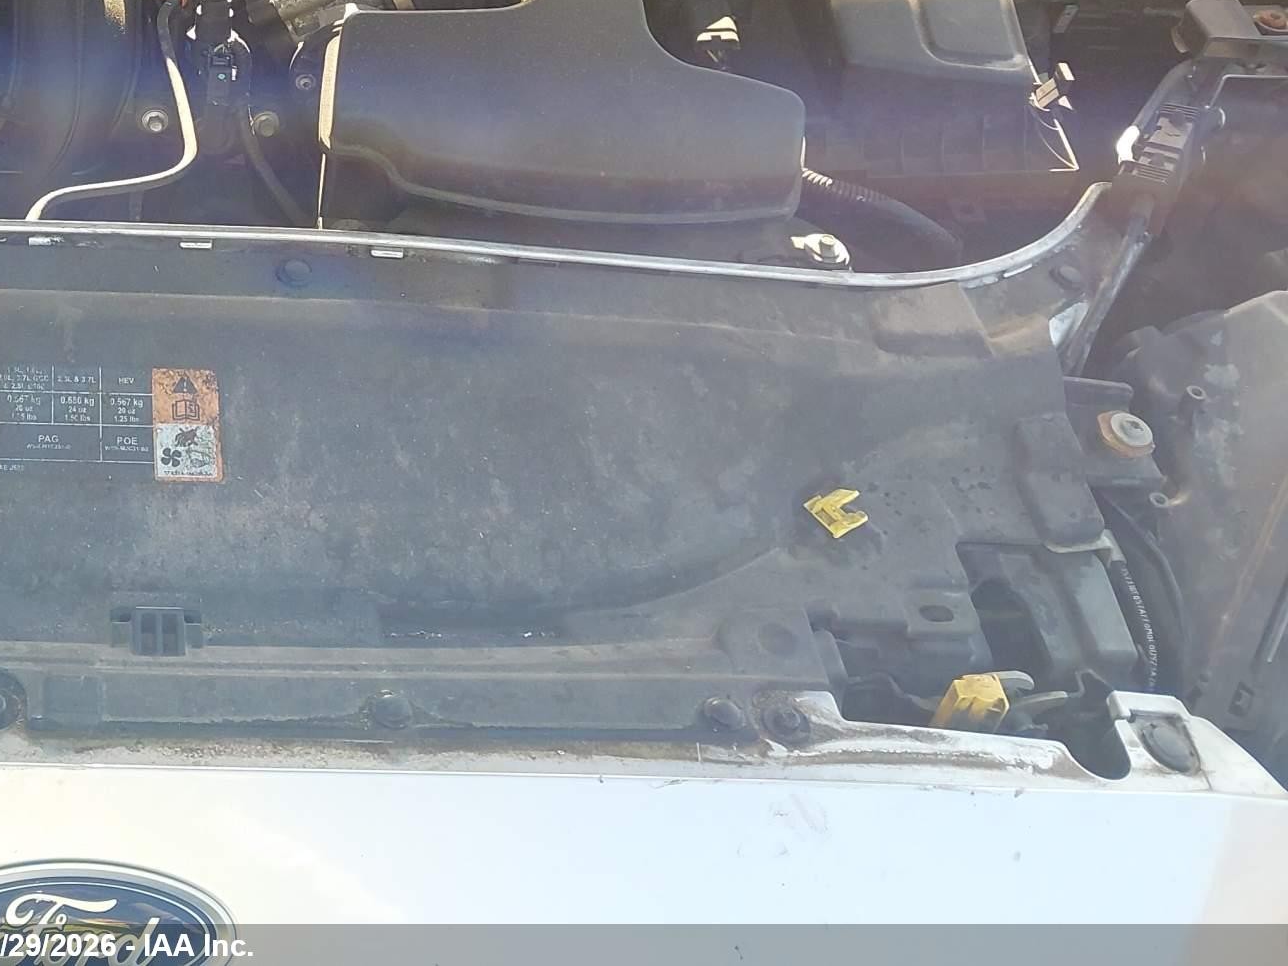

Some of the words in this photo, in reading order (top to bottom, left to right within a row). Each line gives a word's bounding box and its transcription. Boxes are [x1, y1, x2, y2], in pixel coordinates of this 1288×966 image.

[118, 377, 135, 385] HEV
[83, 396, 95, 407] kg
[110, 397, 131, 406] 0.567
[132, 398, 144, 408] kg
[68, 405, 77, 413] 24
[114, 415, 128, 423] 1.25
[38, 434, 59, 443] PAG
[116, 436, 138, 445] POE
